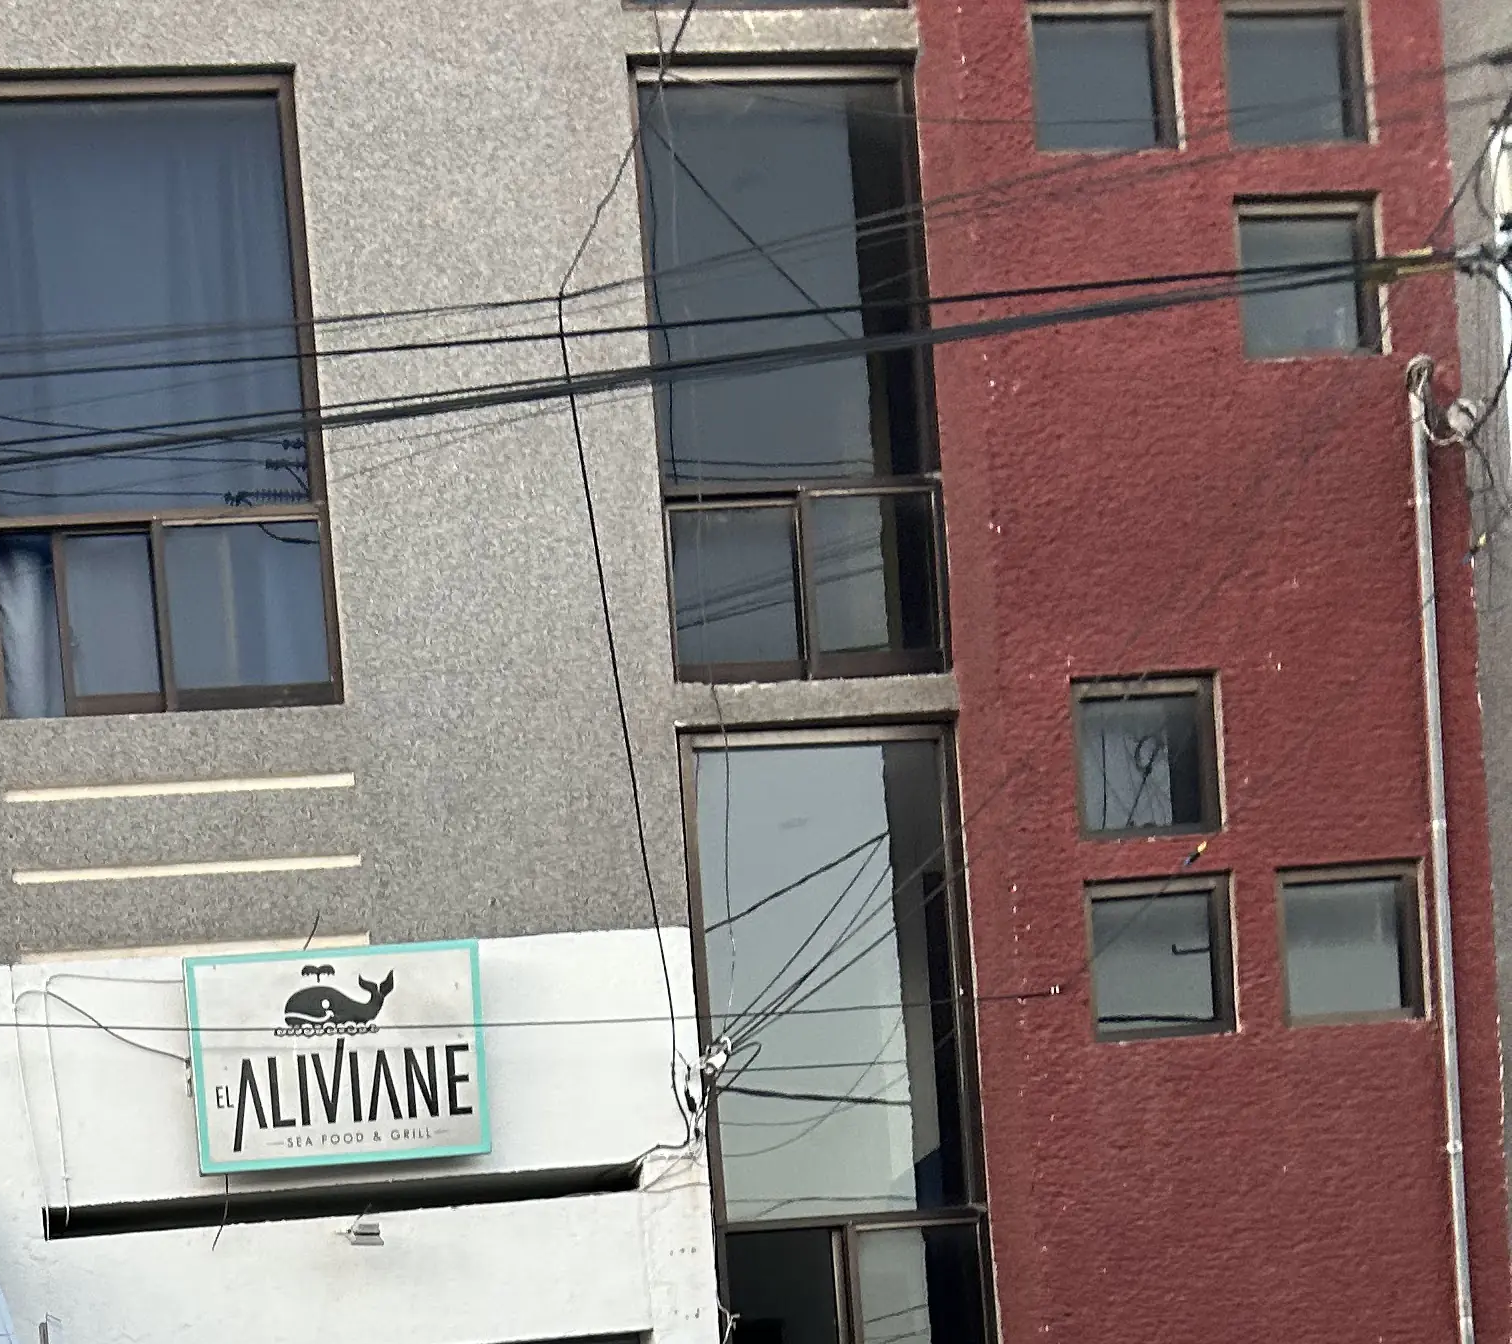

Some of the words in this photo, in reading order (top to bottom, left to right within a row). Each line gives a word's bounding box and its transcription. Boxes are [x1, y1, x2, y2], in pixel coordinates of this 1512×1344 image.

[215, 1085, 234, 1110] EL
[232, 1037, 474, 1153] ALIVIANE
[287, 1136, 314, 1149] SEA
[321, 1131, 365, 1146] FOOD
[373, 1130, 382, 1142] &
[390, 1126, 433, 1141] GRILL
